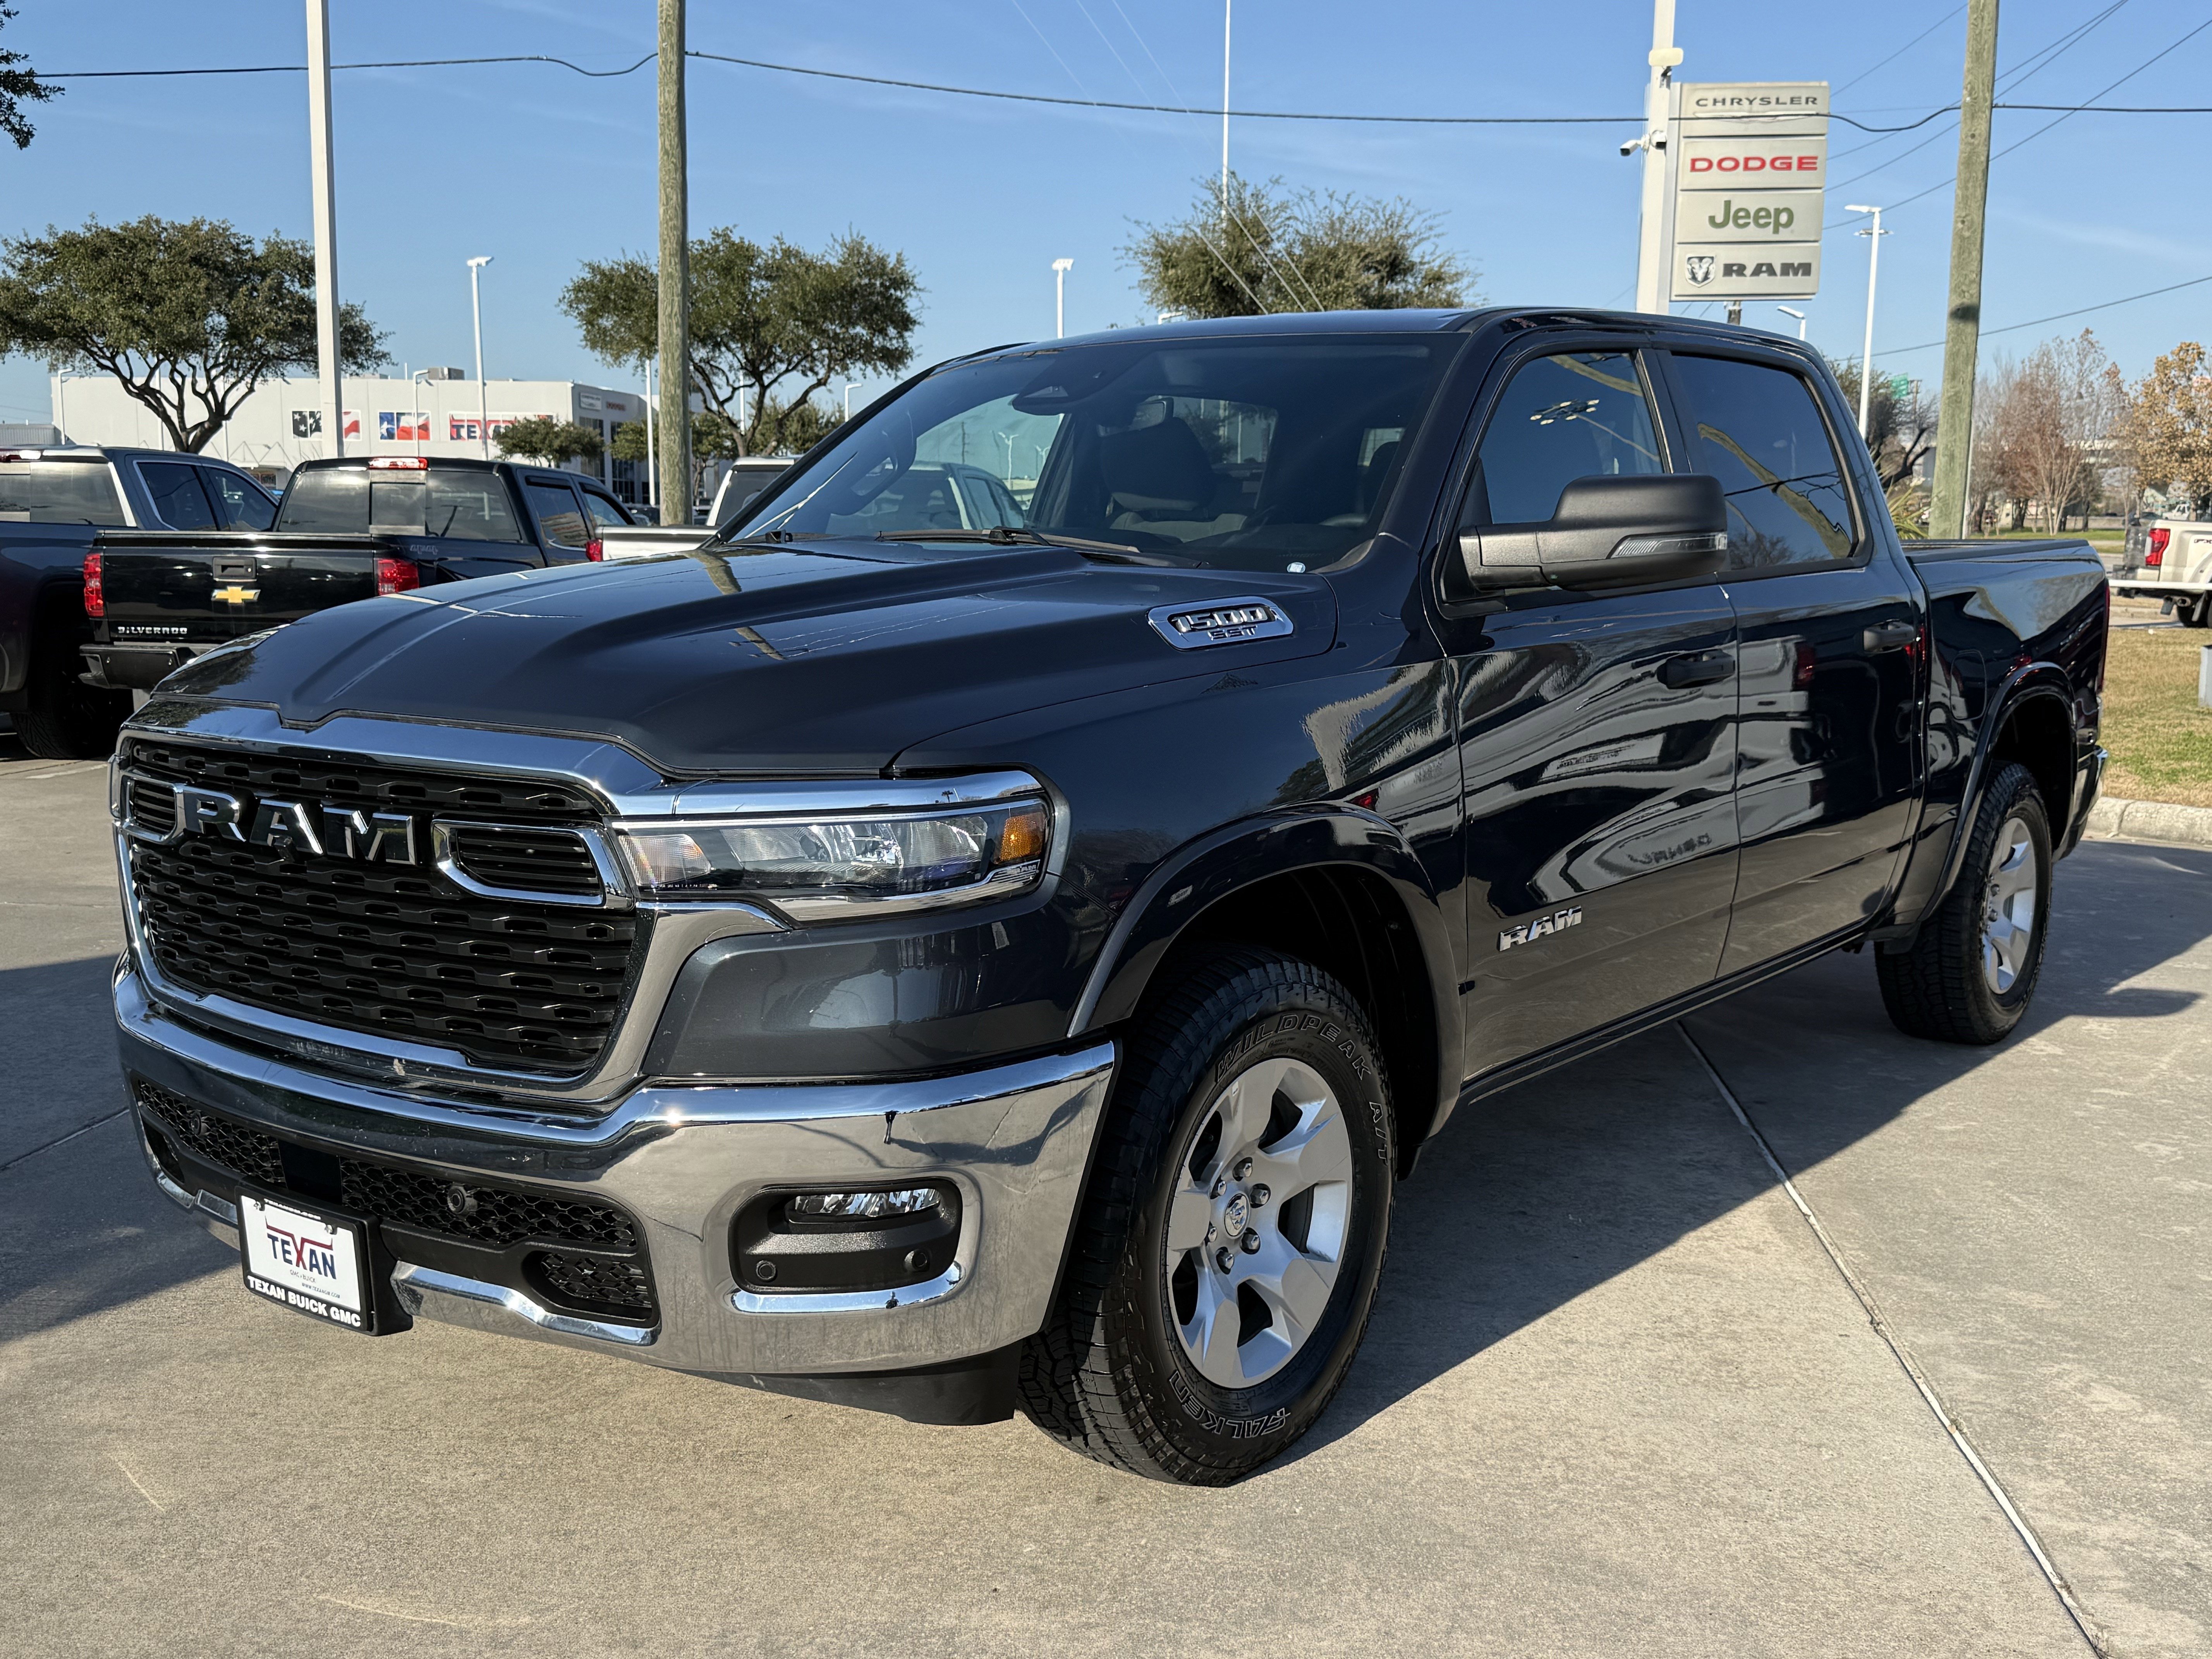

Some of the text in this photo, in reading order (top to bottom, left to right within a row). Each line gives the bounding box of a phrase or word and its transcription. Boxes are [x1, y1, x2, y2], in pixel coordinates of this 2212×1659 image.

[1695, 96, 1818, 107] CHRYSLER
[1689, 156, 1819, 173] DODGE
[1708, 199, 1794, 235] Jeep
[1722, 262, 1812, 278] RAM
[117, 626, 187, 634] SILVERADO
[1171, 606, 1269, 633] 1500
[183, 786, 417, 866] RAM
[1499, 905, 1582, 952] RAM
[1215, 1014, 1389, 1166] WILDPEAK A/T
[266, 1231, 337, 1280] TEXAN
[247, 1275, 361, 1328] TEXAN BUICK GMC
[1169, 1370, 1291, 1439] FALKEN
